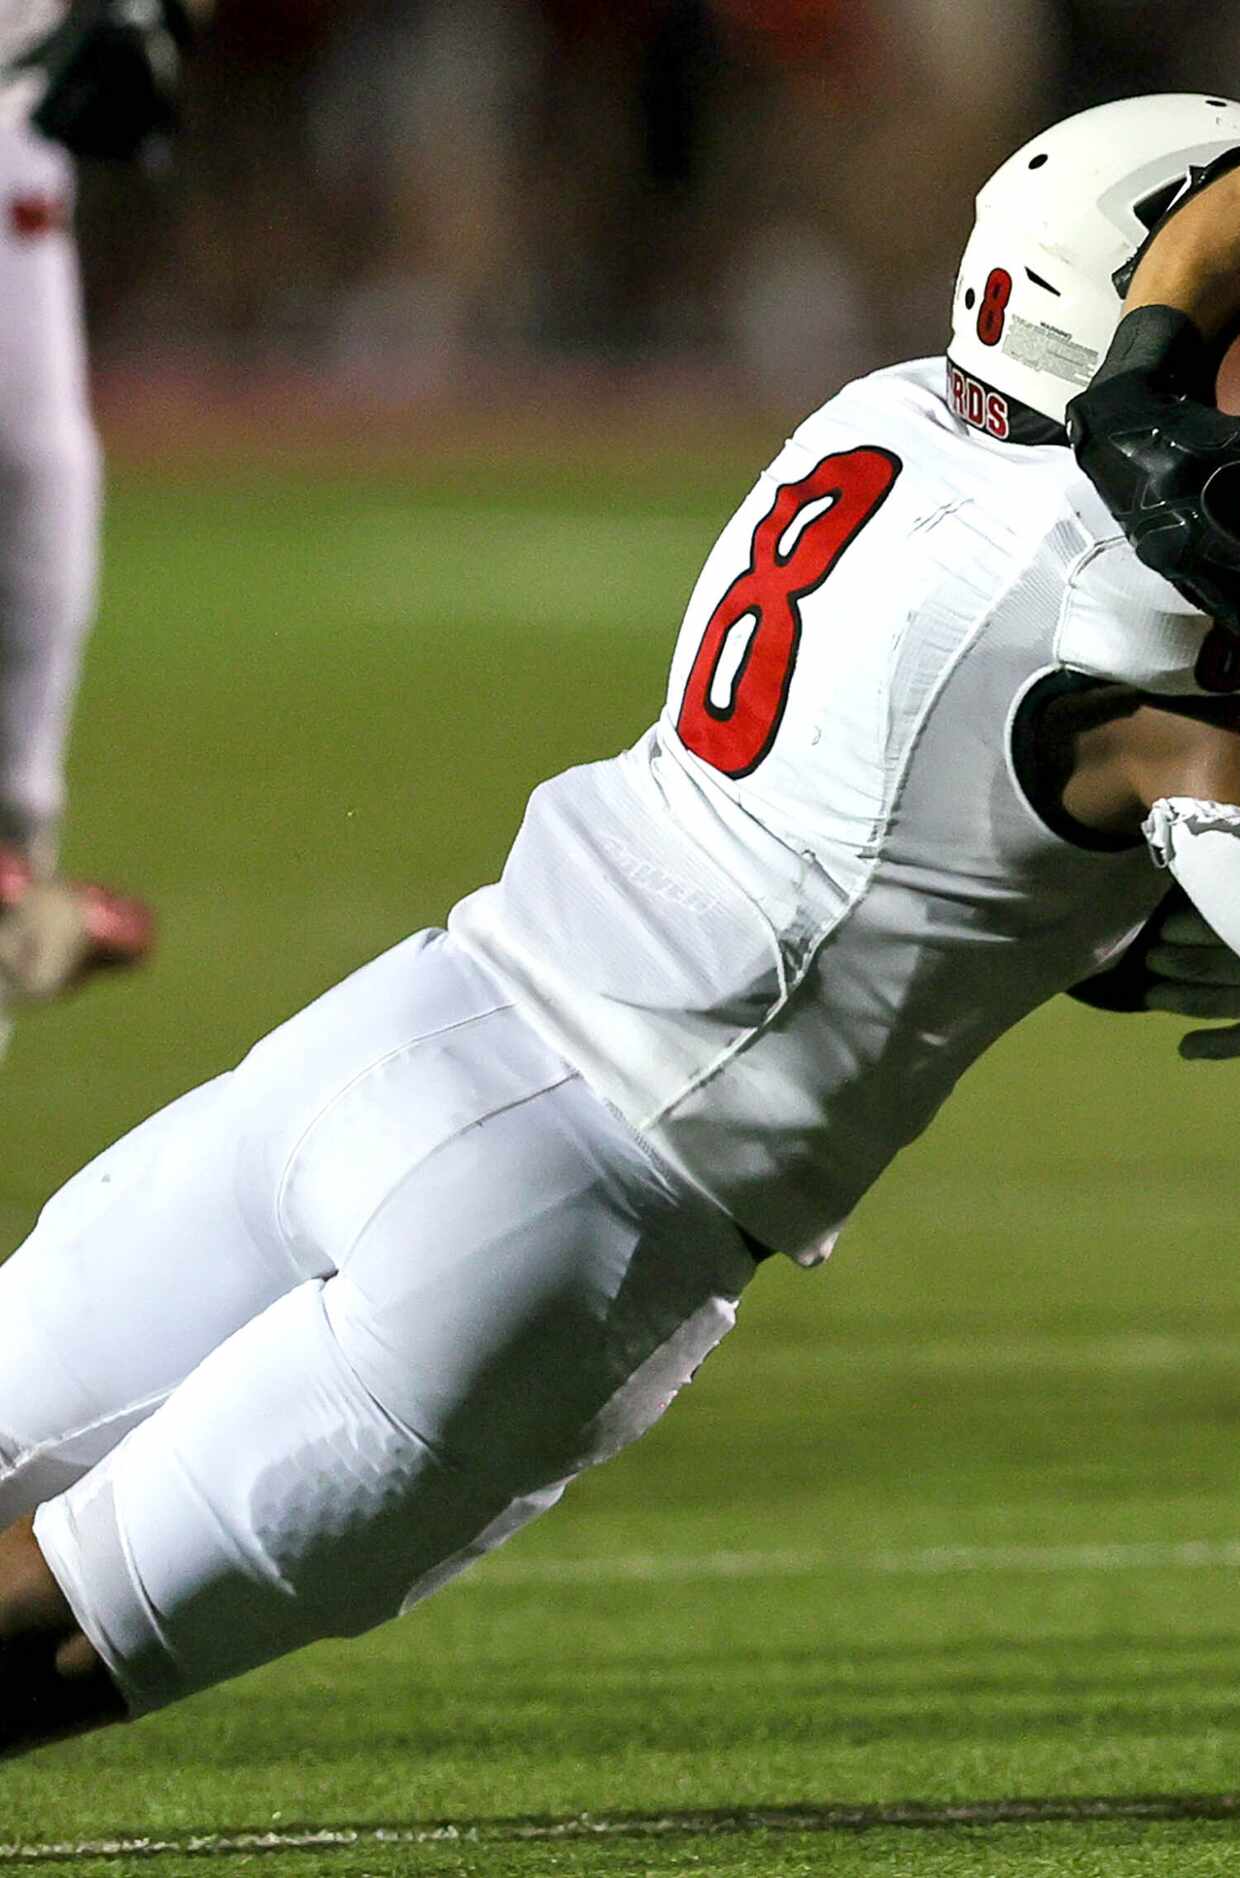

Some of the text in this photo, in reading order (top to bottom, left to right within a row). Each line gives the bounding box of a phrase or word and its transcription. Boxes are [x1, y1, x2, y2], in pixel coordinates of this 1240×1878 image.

[976, 267, 1013, 347] 8
[950, 367, 1010, 440] RDS
[676, 445, 904, 781] 8
